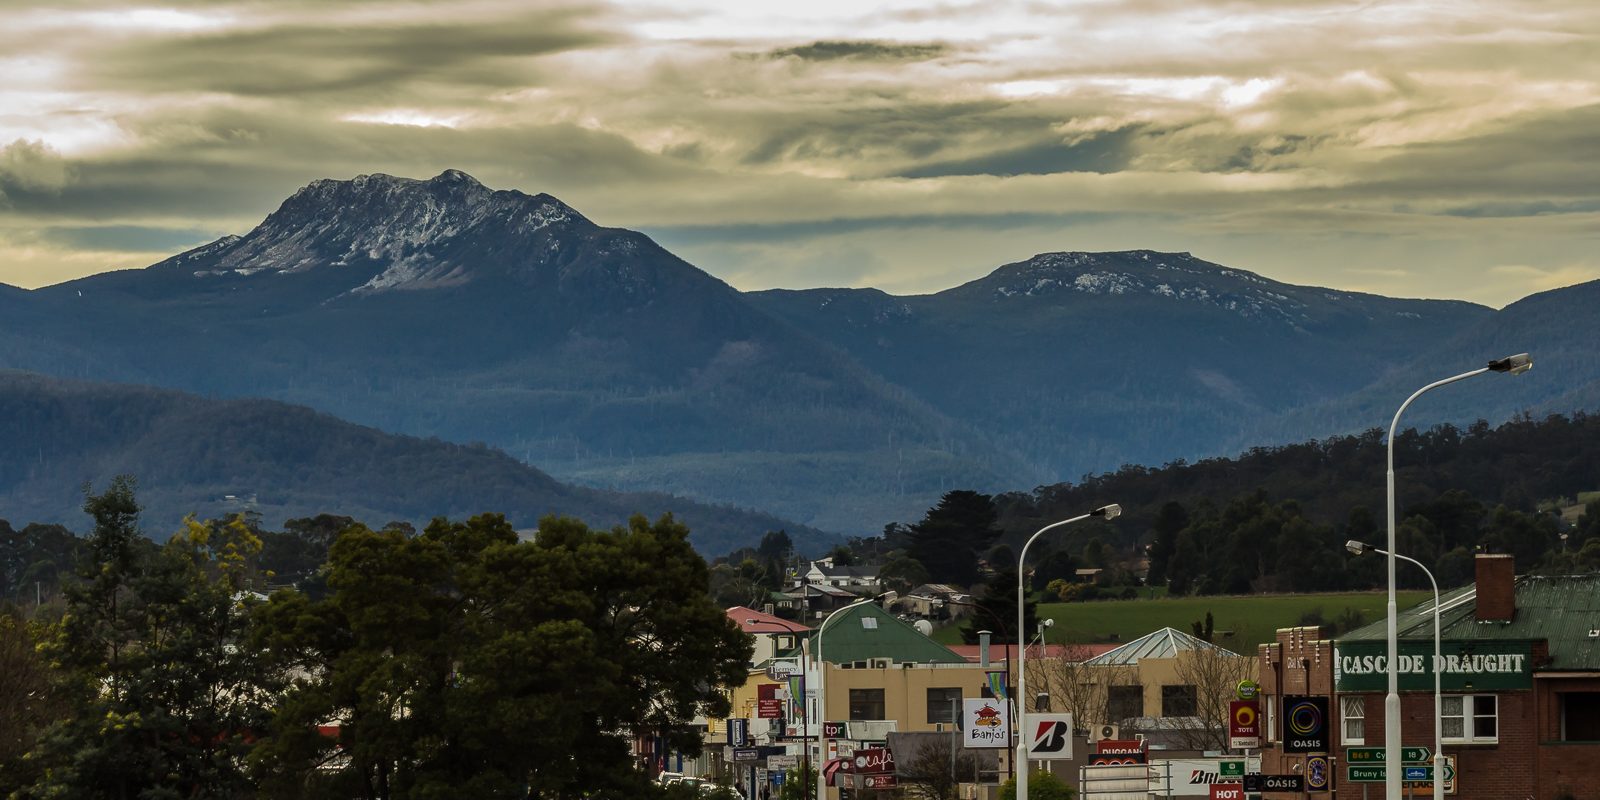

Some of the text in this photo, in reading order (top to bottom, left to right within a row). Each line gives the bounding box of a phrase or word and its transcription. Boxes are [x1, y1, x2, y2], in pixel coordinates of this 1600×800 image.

[1432, 654, 1525, 673] DRAUGHT
[826, 725, 843, 736] tpr
[971, 728, 1006, 744] Banjo's
[1293, 740, 1321, 748] OASIS
[1353, 770, 1378, 778] Bruny
[1266, 779, 1298, 788] OASIS
[1216, 790, 1239, 799] HOT
